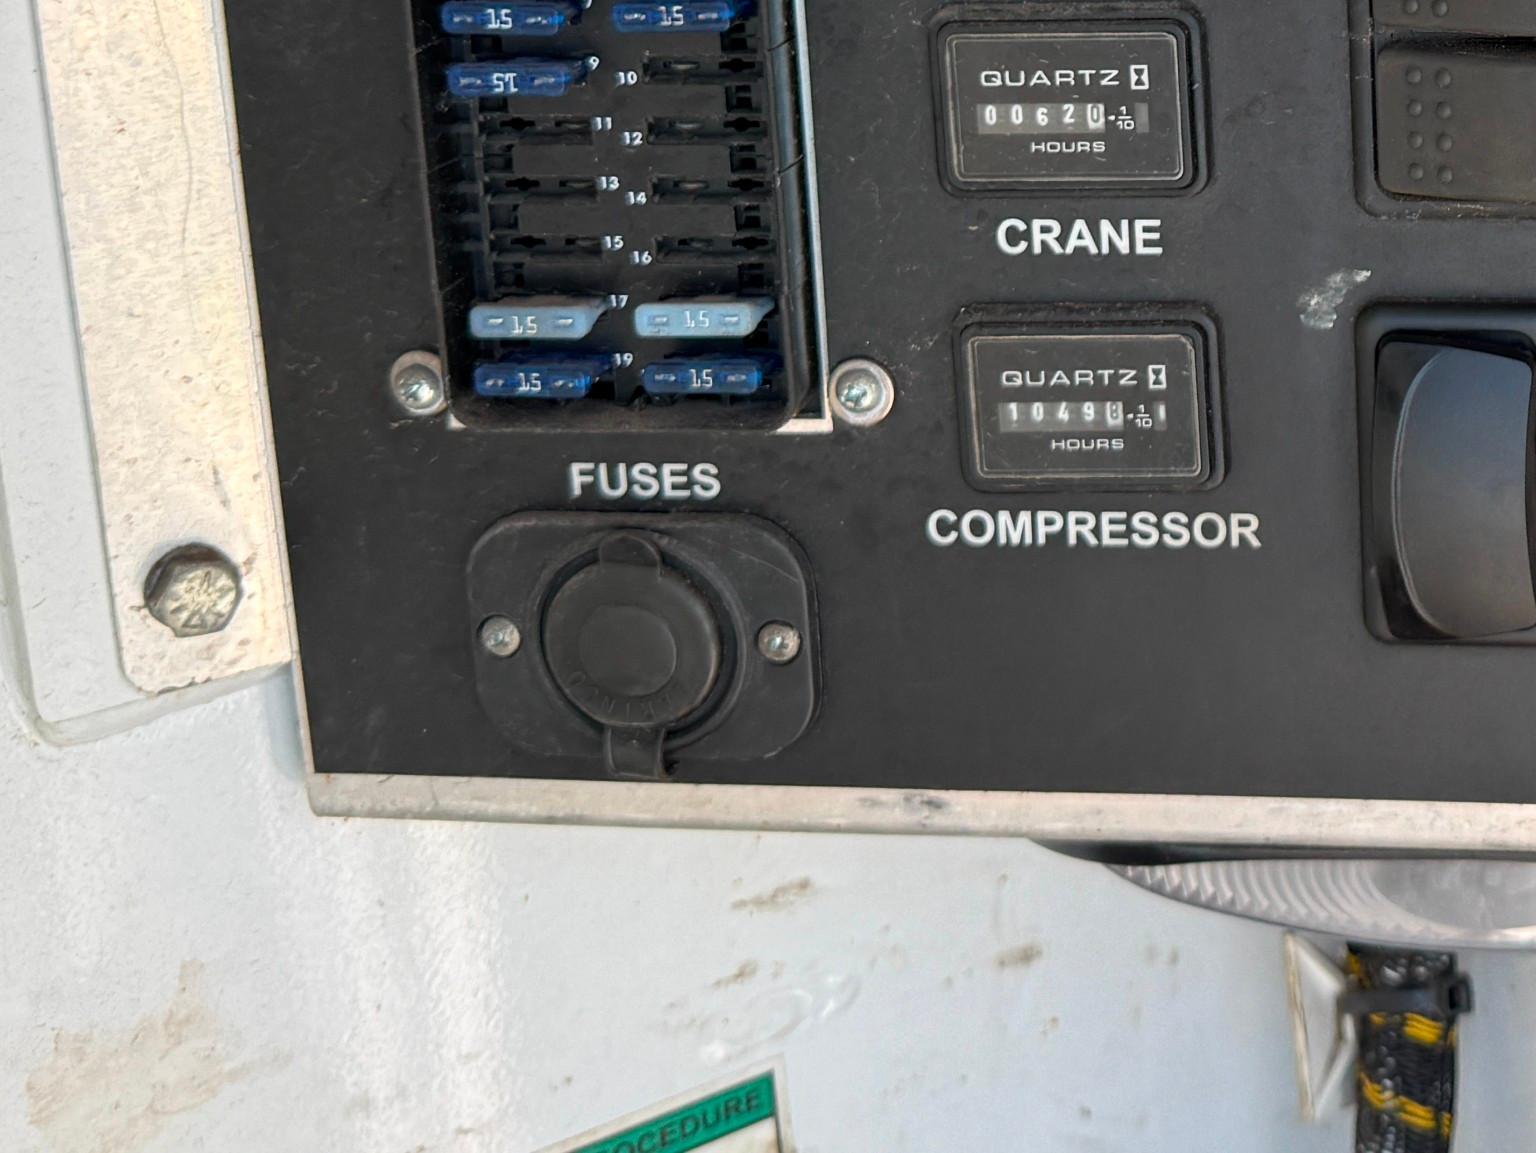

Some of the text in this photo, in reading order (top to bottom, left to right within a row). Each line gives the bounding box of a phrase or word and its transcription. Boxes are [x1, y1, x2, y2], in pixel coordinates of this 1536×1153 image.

[485, 8, 513, 30] 15
[658, 5, 684, 26] 15
[588, 56, 600, 70] 9
[616, 70, 638, 85] 10
[980, 69, 1120, 87] QUARTZ
[594, 116, 612, 130] 11
[622, 131, 643, 146] 12
[1030, 141, 1106, 153] HOURS
[600, 175, 620, 190] 13
[626, 191, 647, 205] 14
[603, 235, 624, 250] 15
[996, 218, 1163, 255] CRANE
[632, 250, 653, 265] 16
[609, 294, 629, 308] 17
[511, 315, 538, 335] 15
[684, 310, 710, 329] 15
[613, 352, 634, 367] 19
[516, 372, 542, 392] 15
[688, 368, 713, 389] 15
[1001, 369, 1138, 387] QUARTZ
[1050, 438, 1125, 451] HOURS
[568, 461, 721, 499] FUSES
[926, 509, 1262, 548] COMPRESSOR
[597, 1089, 762, 1153] OCEDURE
